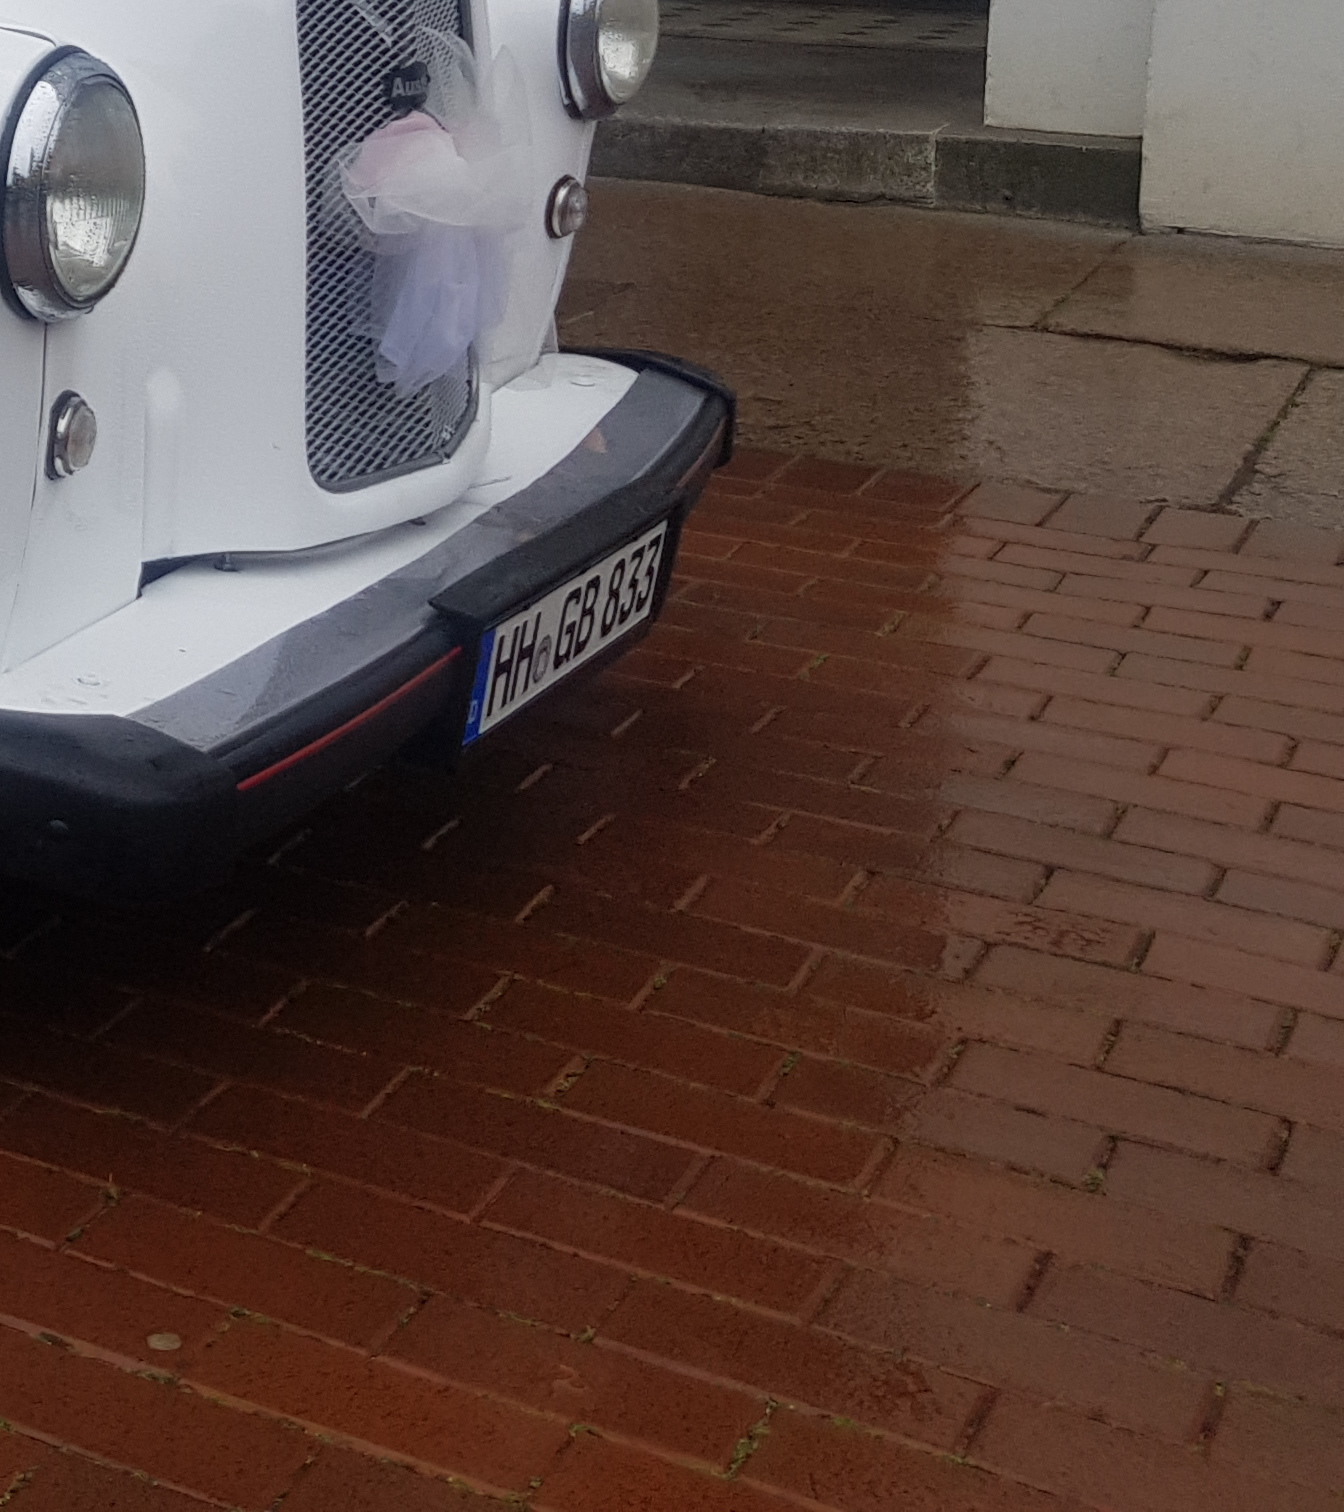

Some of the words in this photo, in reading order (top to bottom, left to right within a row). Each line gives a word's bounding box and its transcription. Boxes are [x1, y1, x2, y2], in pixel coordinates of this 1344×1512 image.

[486, 611, 542, 718] HH
[553, 574, 601, 671] GB
[600, 533, 663, 638] 833
